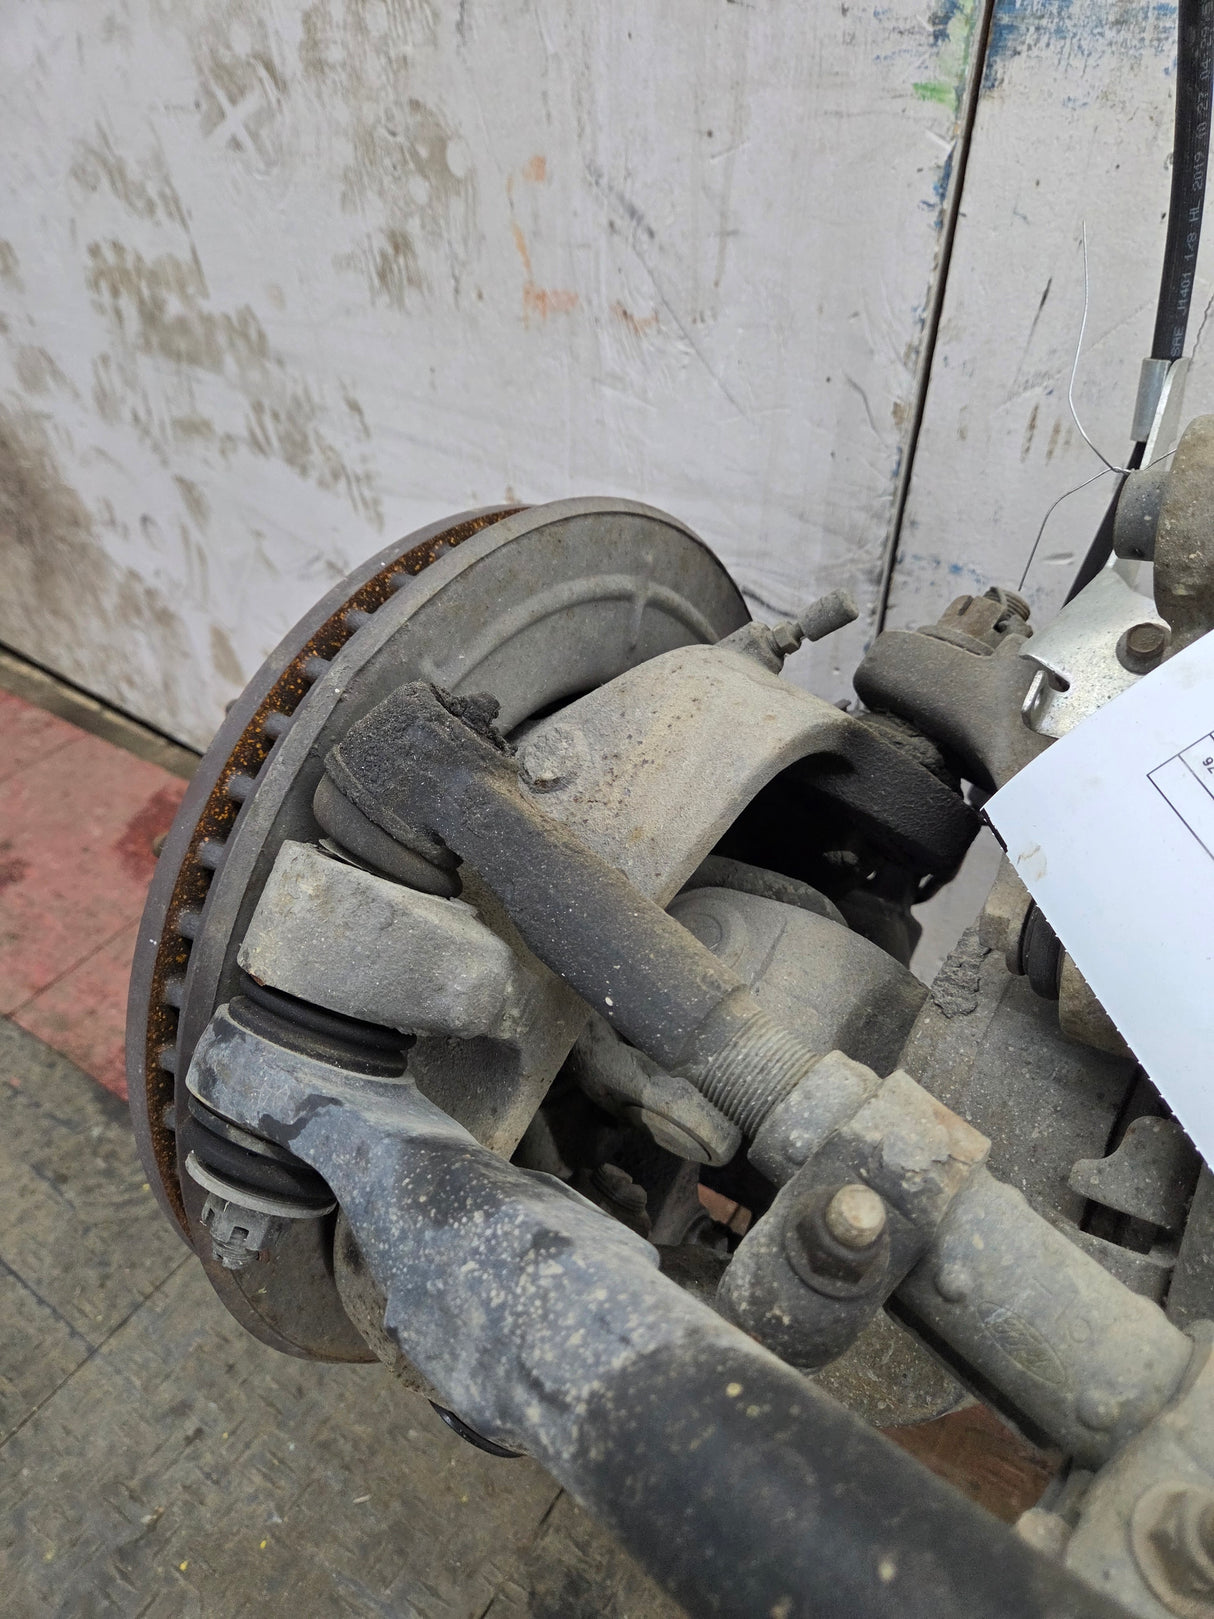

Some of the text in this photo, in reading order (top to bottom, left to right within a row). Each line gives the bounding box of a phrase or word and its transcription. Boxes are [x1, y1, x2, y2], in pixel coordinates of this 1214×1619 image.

[1189, 200, 1200, 222] HL
[1184, 232, 1197, 262] 1/8
[1177, 272, 1192, 316] J1401
[1171, 326, 1185, 357] SAE
